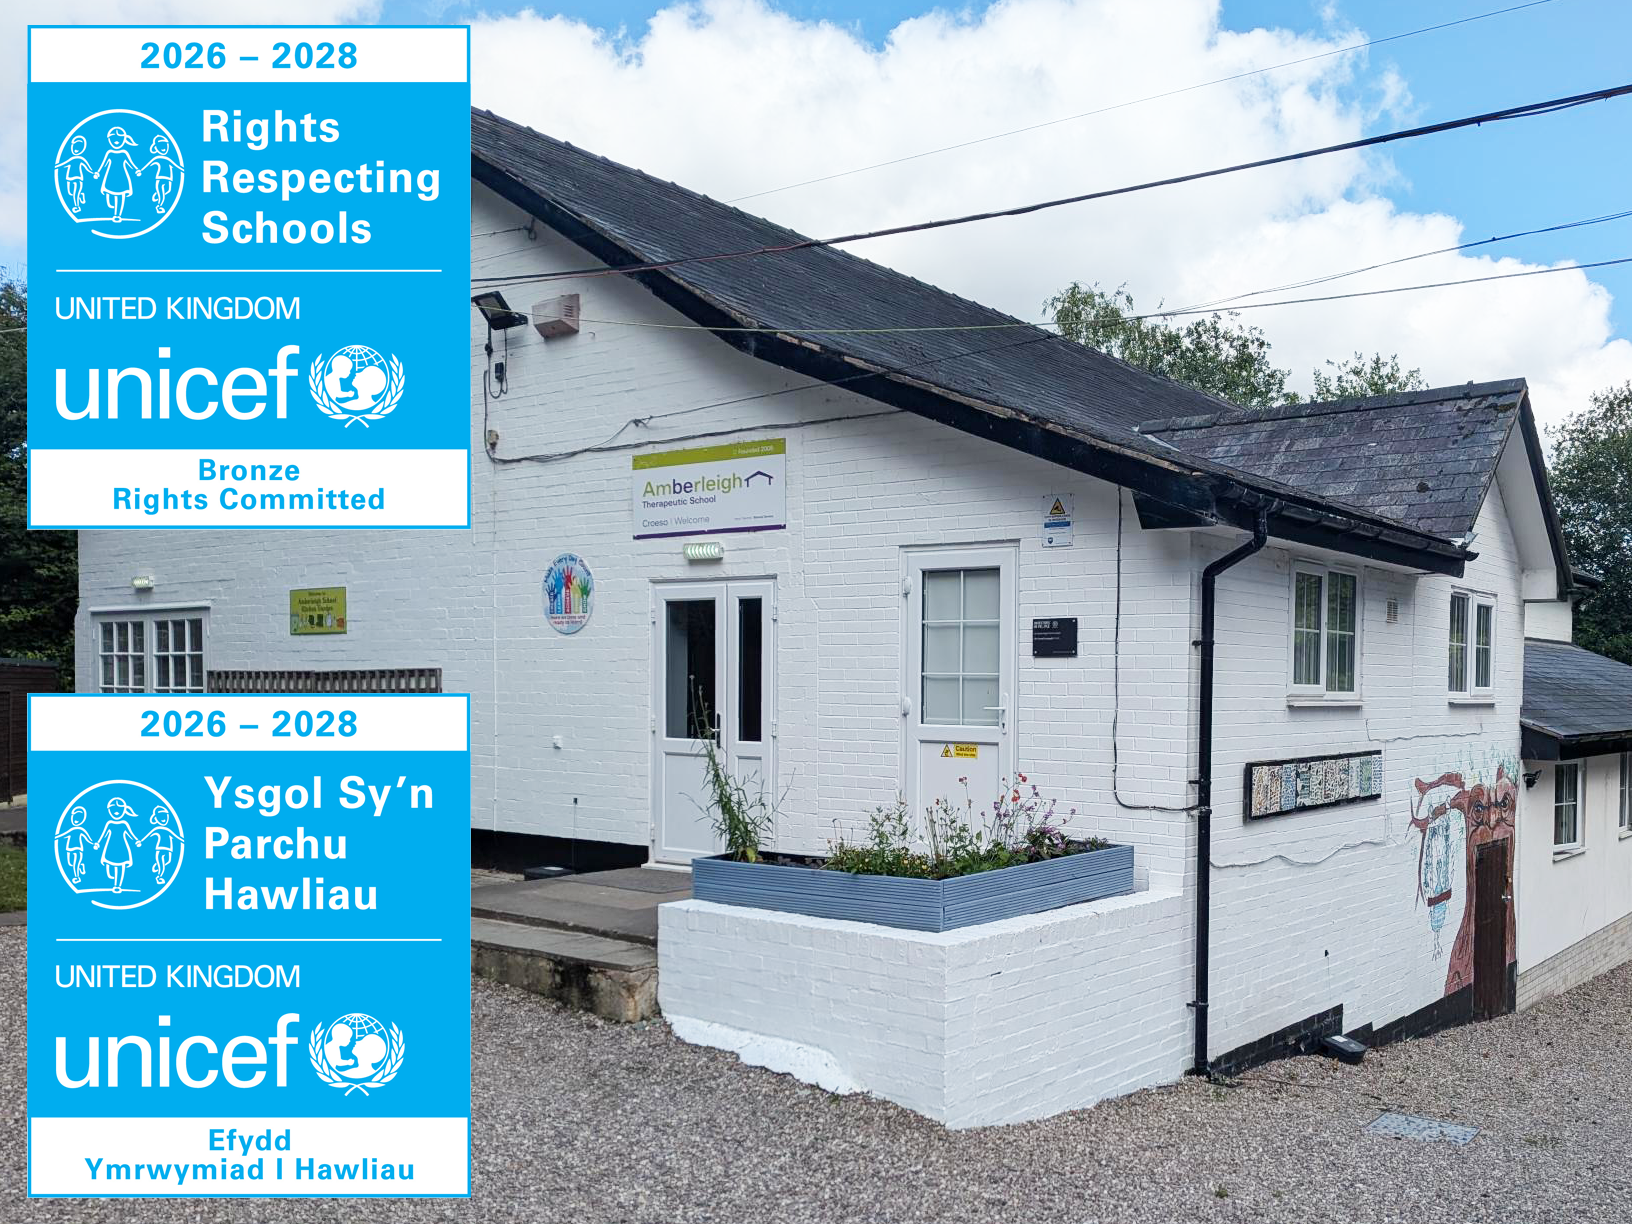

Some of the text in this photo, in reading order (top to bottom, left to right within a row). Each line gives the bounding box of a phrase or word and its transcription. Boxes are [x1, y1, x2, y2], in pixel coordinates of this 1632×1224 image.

[642, 472, 742, 498] Amberleigh
[642, 495, 716, 509] Therapeutic School
[642, 515, 710, 528] Croeso Welcome
[553, 556, 567, 566] Every
[568, 555, 578, 564] Day
[955, 745, 977, 753] Caution
